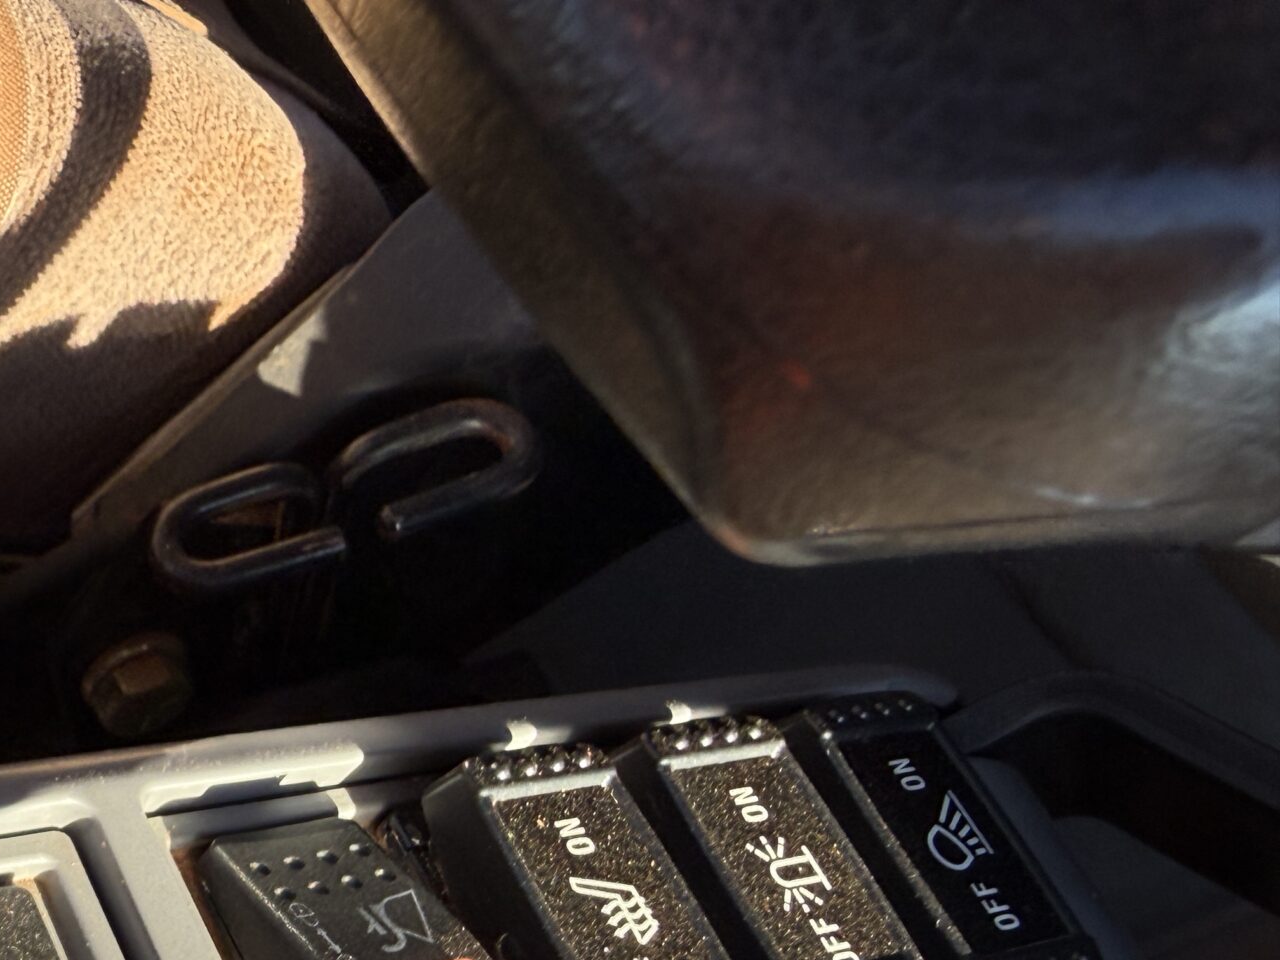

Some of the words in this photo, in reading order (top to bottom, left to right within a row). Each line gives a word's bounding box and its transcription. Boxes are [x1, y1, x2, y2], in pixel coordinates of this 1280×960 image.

[888, 757, 926, 792] ON
[729, 786, 769, 823] ON
[554, 818, 595, 856] ON
[970, 881, 1021, 931] OFF
